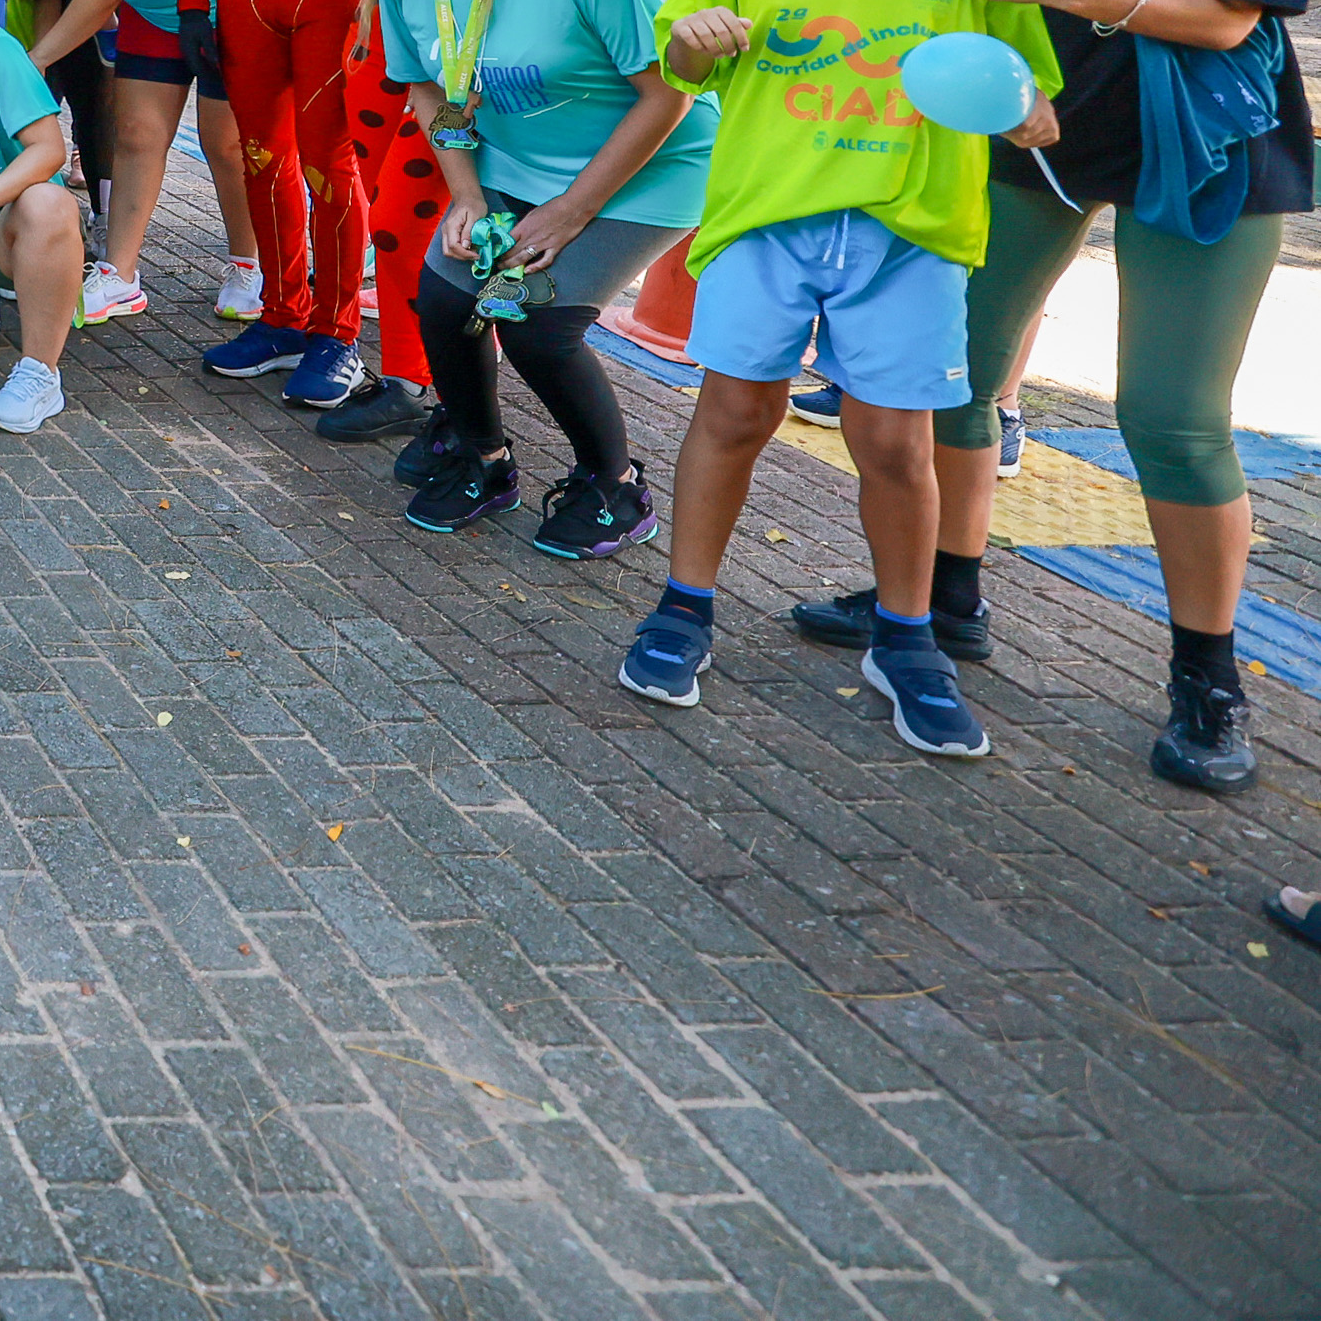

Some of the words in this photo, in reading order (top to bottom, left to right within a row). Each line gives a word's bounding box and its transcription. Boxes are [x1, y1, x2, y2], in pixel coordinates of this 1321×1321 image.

[776, 8, 808, 21] 2ª
[756, 52, 840, 75] Corrida
[840, 36, 871, 56] da
[833, 138, 890, 153] ALECE
